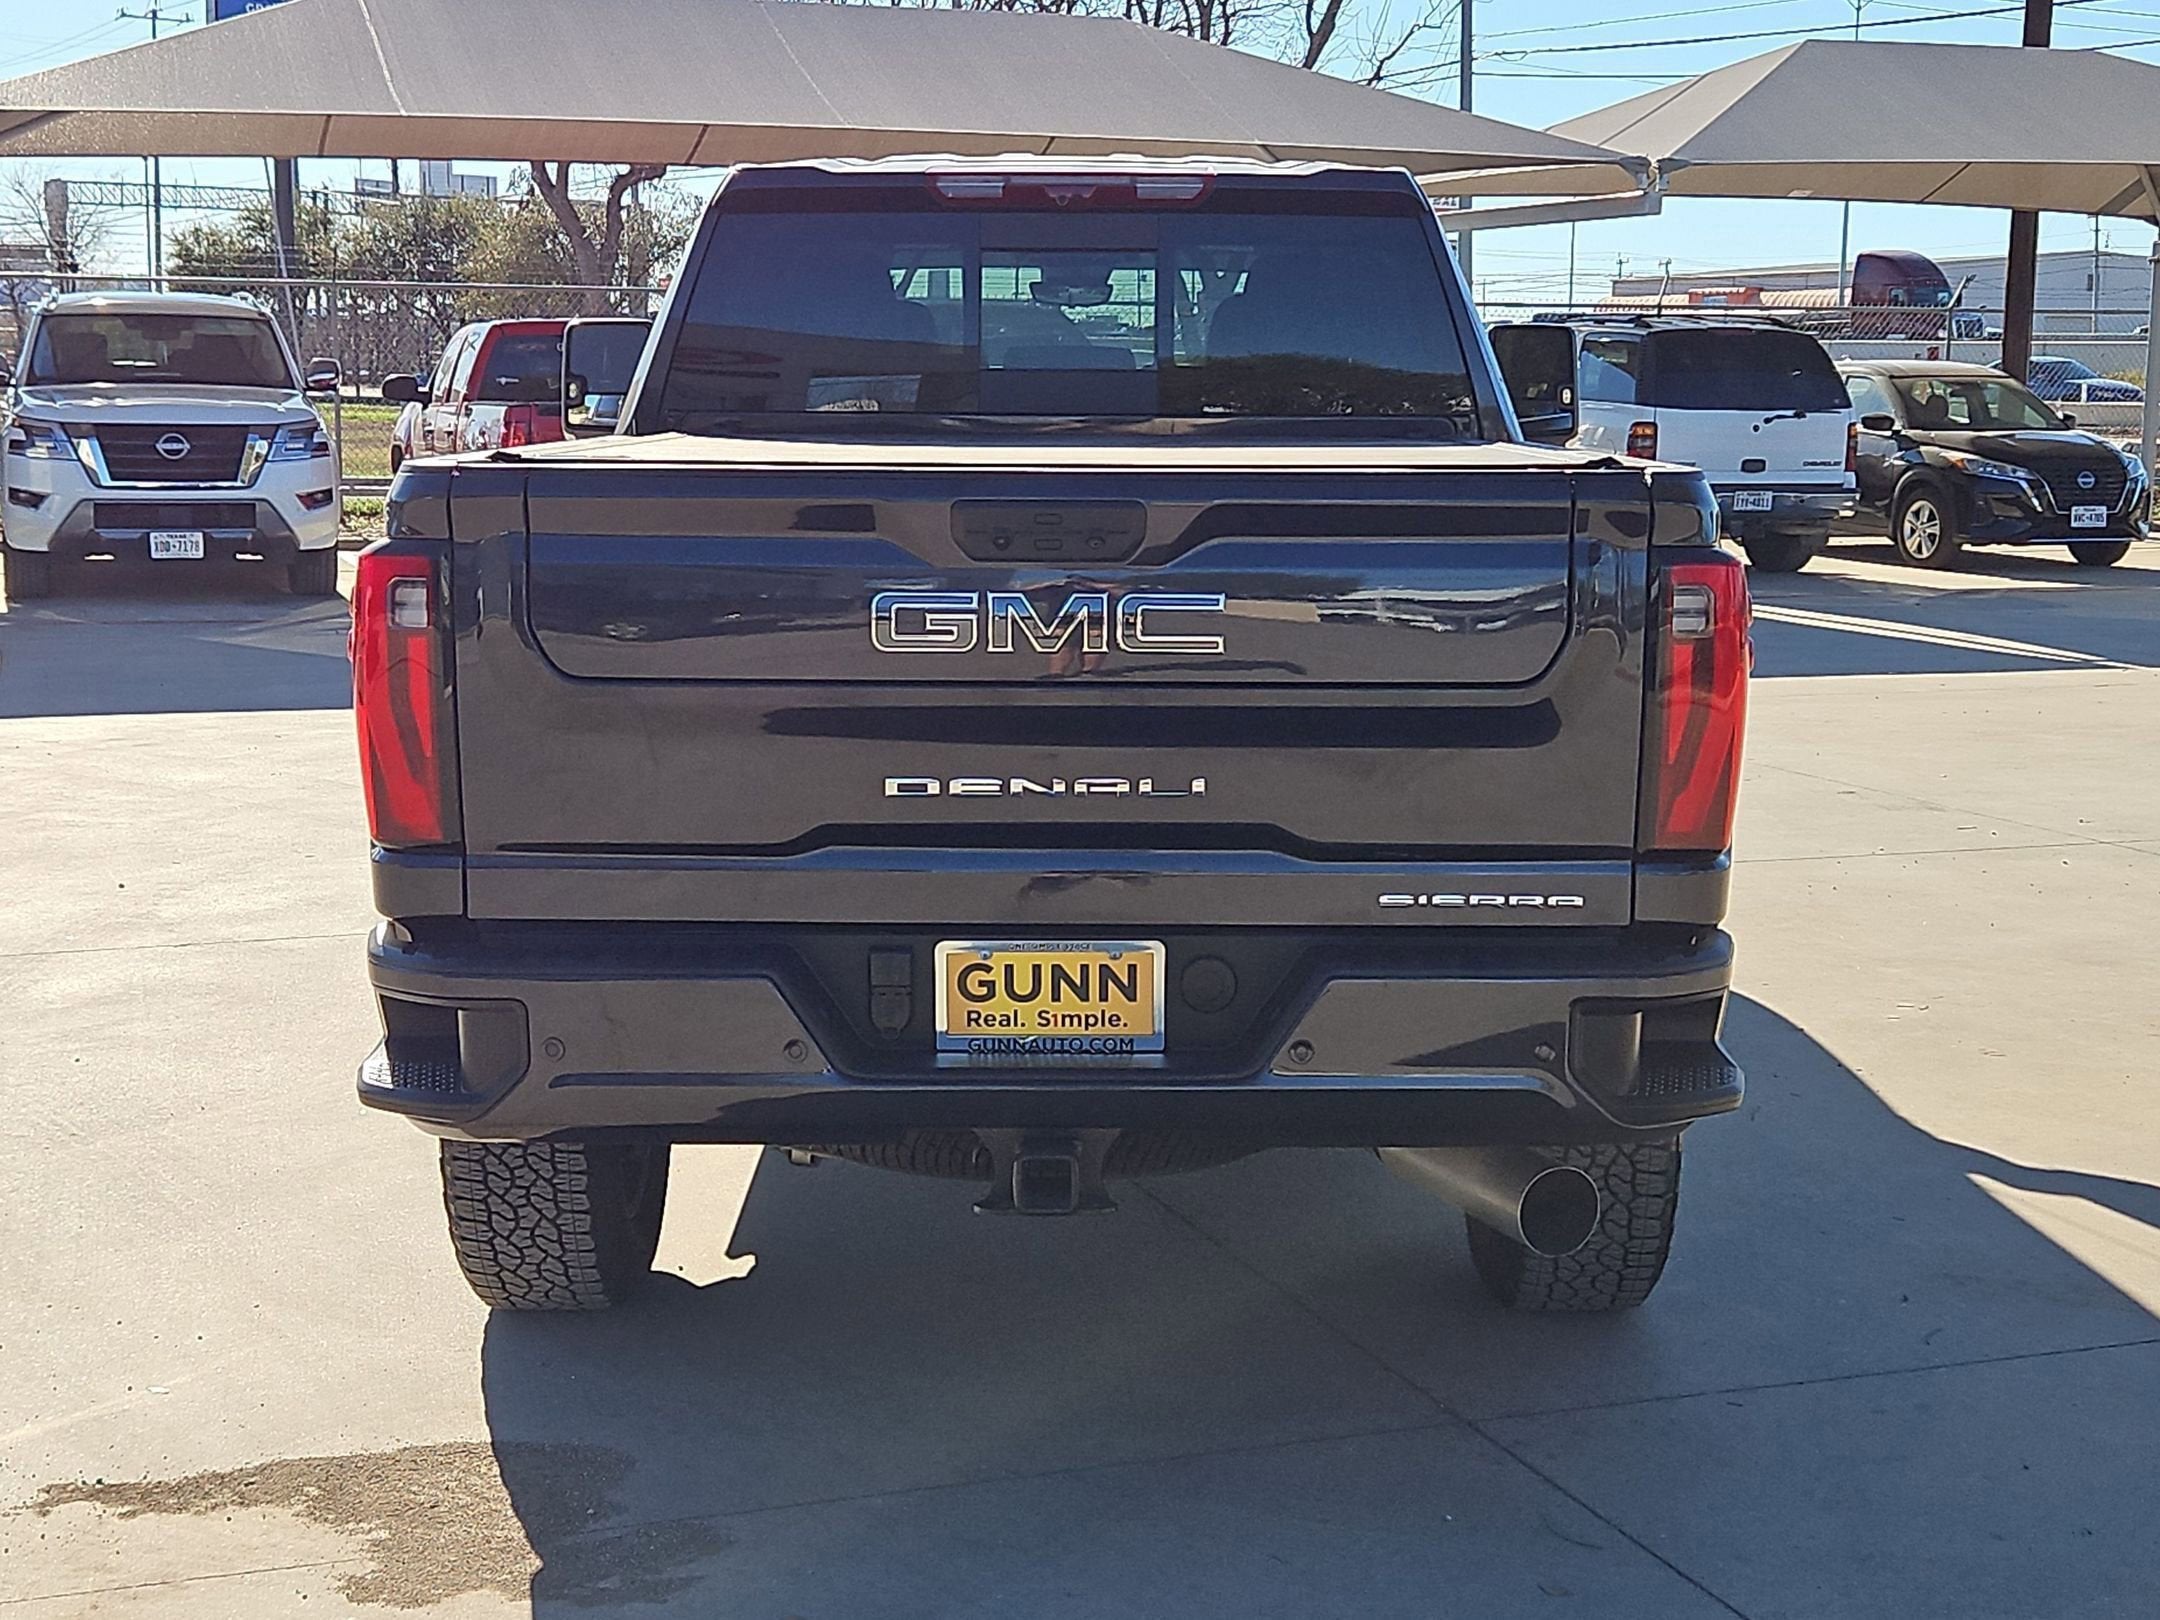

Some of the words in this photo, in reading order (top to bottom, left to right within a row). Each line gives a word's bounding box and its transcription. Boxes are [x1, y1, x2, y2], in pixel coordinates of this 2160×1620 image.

[870, 591, 1226, 655] GMC
[884, 777, 1206, 797] DENALI
[1378, 893, 1585, 908] SIERRA
[957, 963, 1138, 1003] GUNN
[966, 1009, 1026, 1028] Real.
[967, 1037, 1135, 1054] GUNNAUTO.COM
